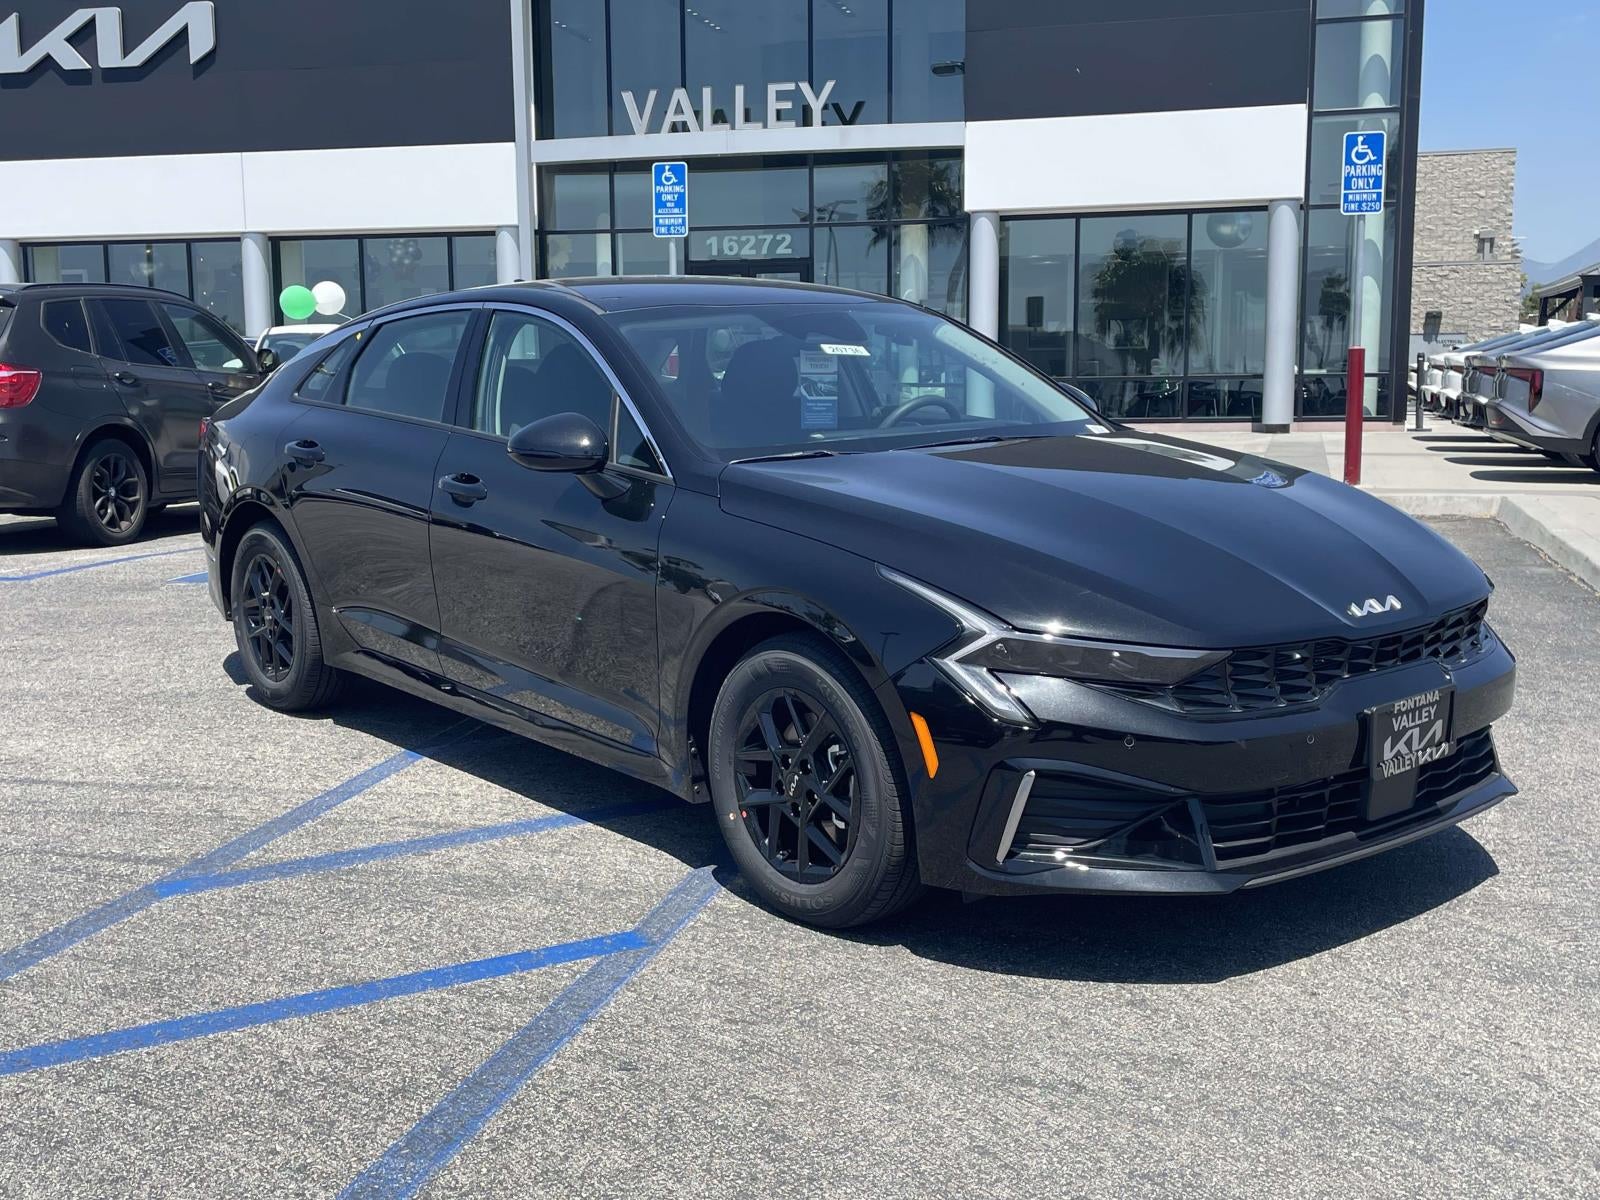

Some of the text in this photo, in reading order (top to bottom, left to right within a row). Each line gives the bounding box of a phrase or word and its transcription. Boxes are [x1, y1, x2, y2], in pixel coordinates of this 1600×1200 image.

[621, 80, 836, 135] VALLEY
[1345, 164, 1382, 177] PARKING
[656, 185, 684, 193] PARKING
[1351, 178, 1374, 189] ONLY
[1344, 202, 1380, 211] FINE $250
[1348, 193, 1377, 201] MINIMUM
[658, 217, 683, 225] MINIMUM
[705, 233, 793, 256] 16272
[1348, 595, 1402, 617] KIA
[1394, 690, 1440, 714] FONTANA
[1392, 705, 1438, 732] VALLEY
[1383, 719, 1444, 761] KIA
[1379, 743, 1450, 779] VALLEY KIA
